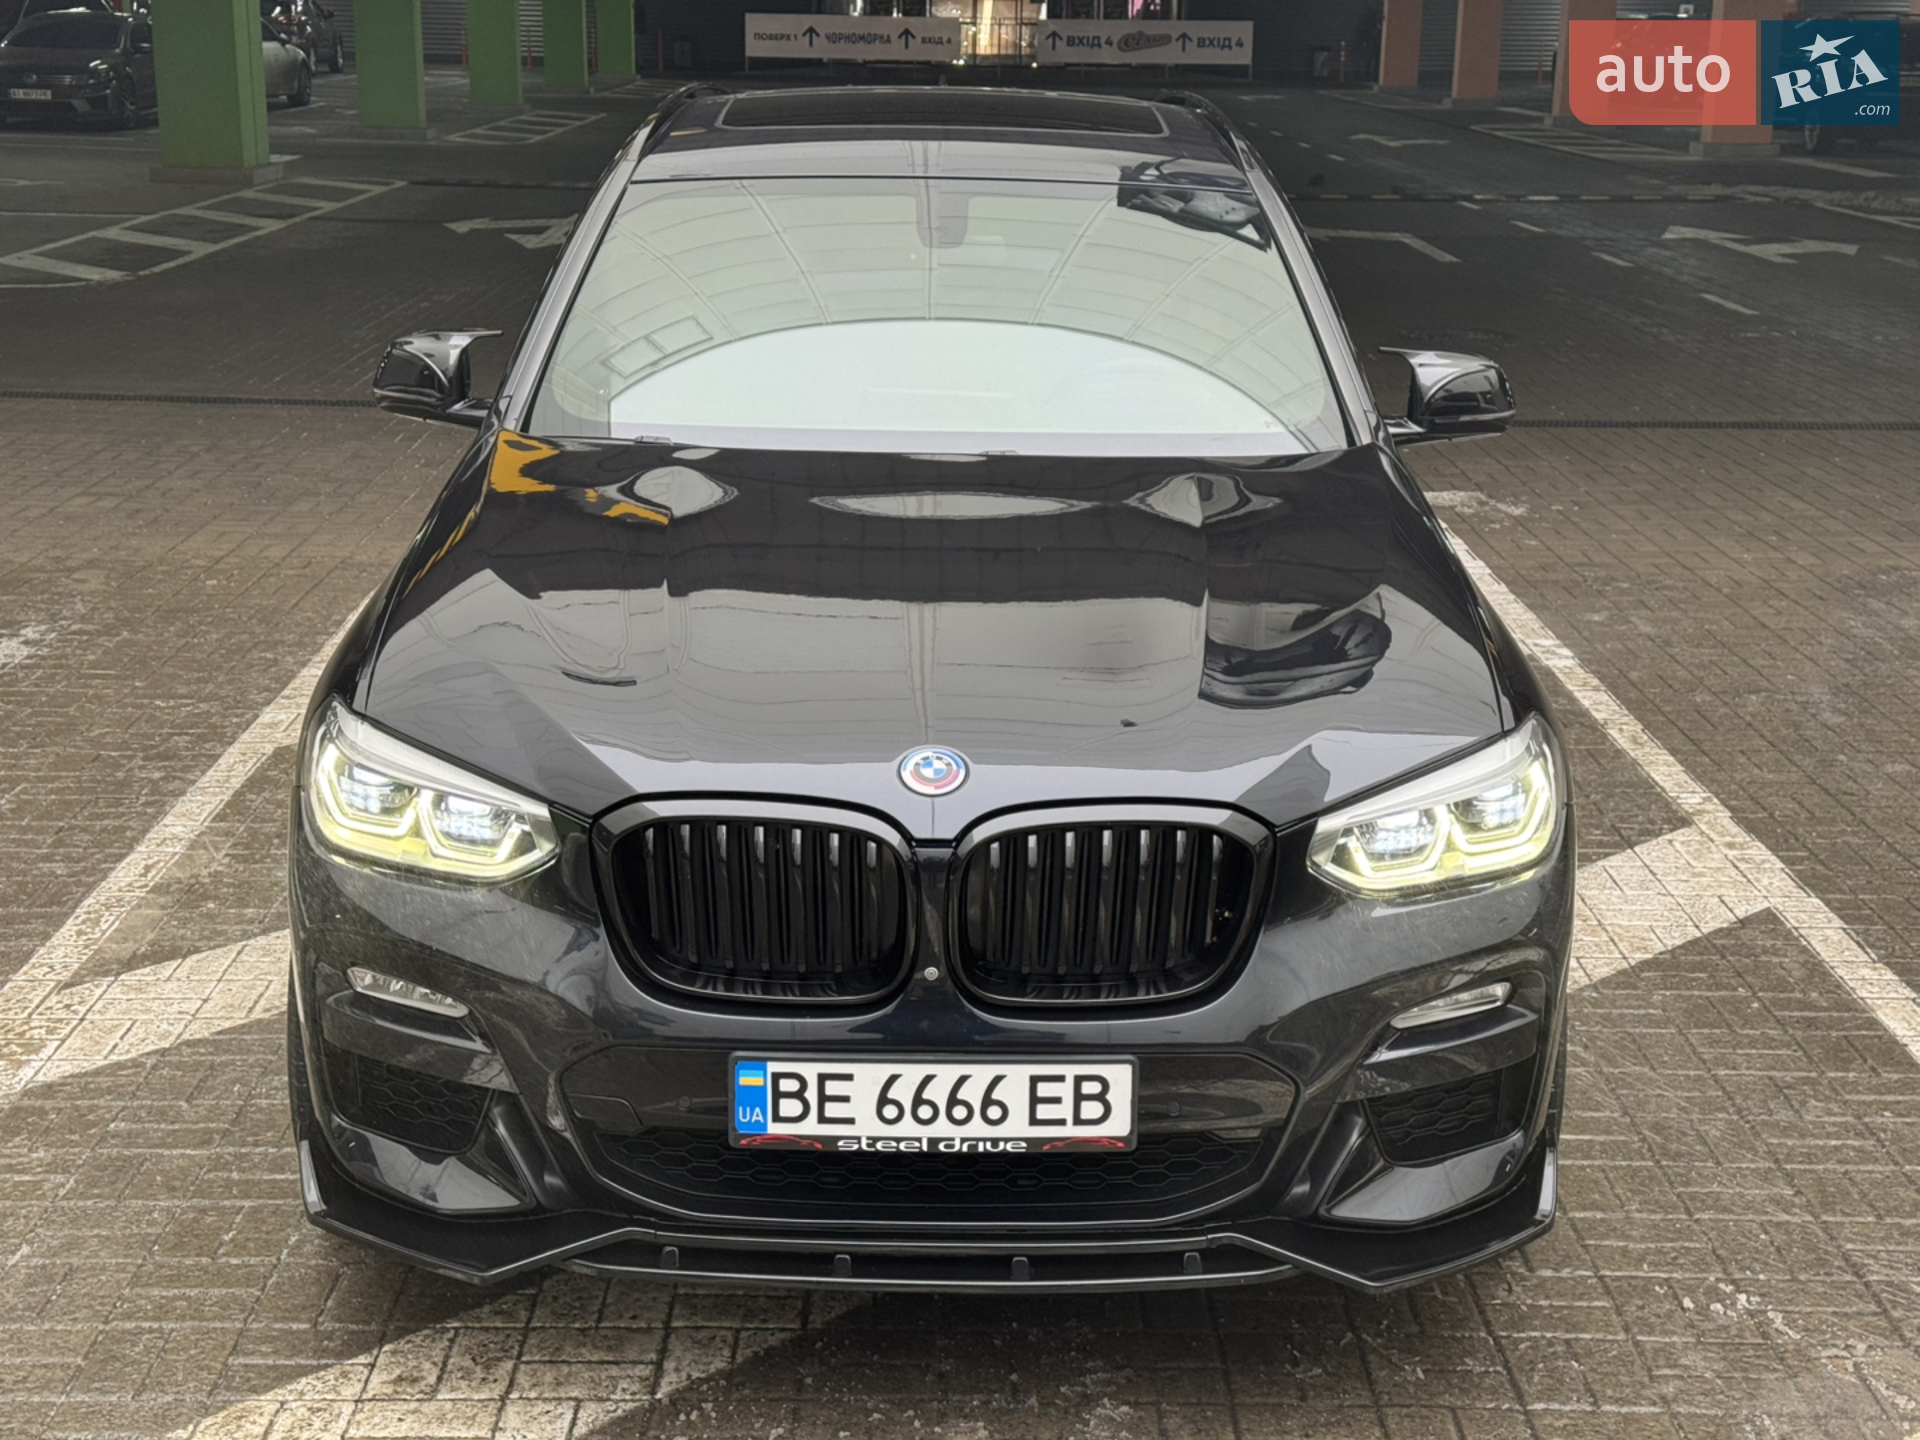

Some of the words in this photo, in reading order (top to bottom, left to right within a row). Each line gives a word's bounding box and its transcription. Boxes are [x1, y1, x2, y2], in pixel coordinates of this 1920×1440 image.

[771, 1072, 856, 1125] BE
[876, 1074, 1009, 1126] 6666
[1028, 1075, 1112, 1127] EB
[739, 1107, 764, 1123] UA
[837, 1136, 928, 1152] steel
[938, 1137, 1027, 1152] drive
